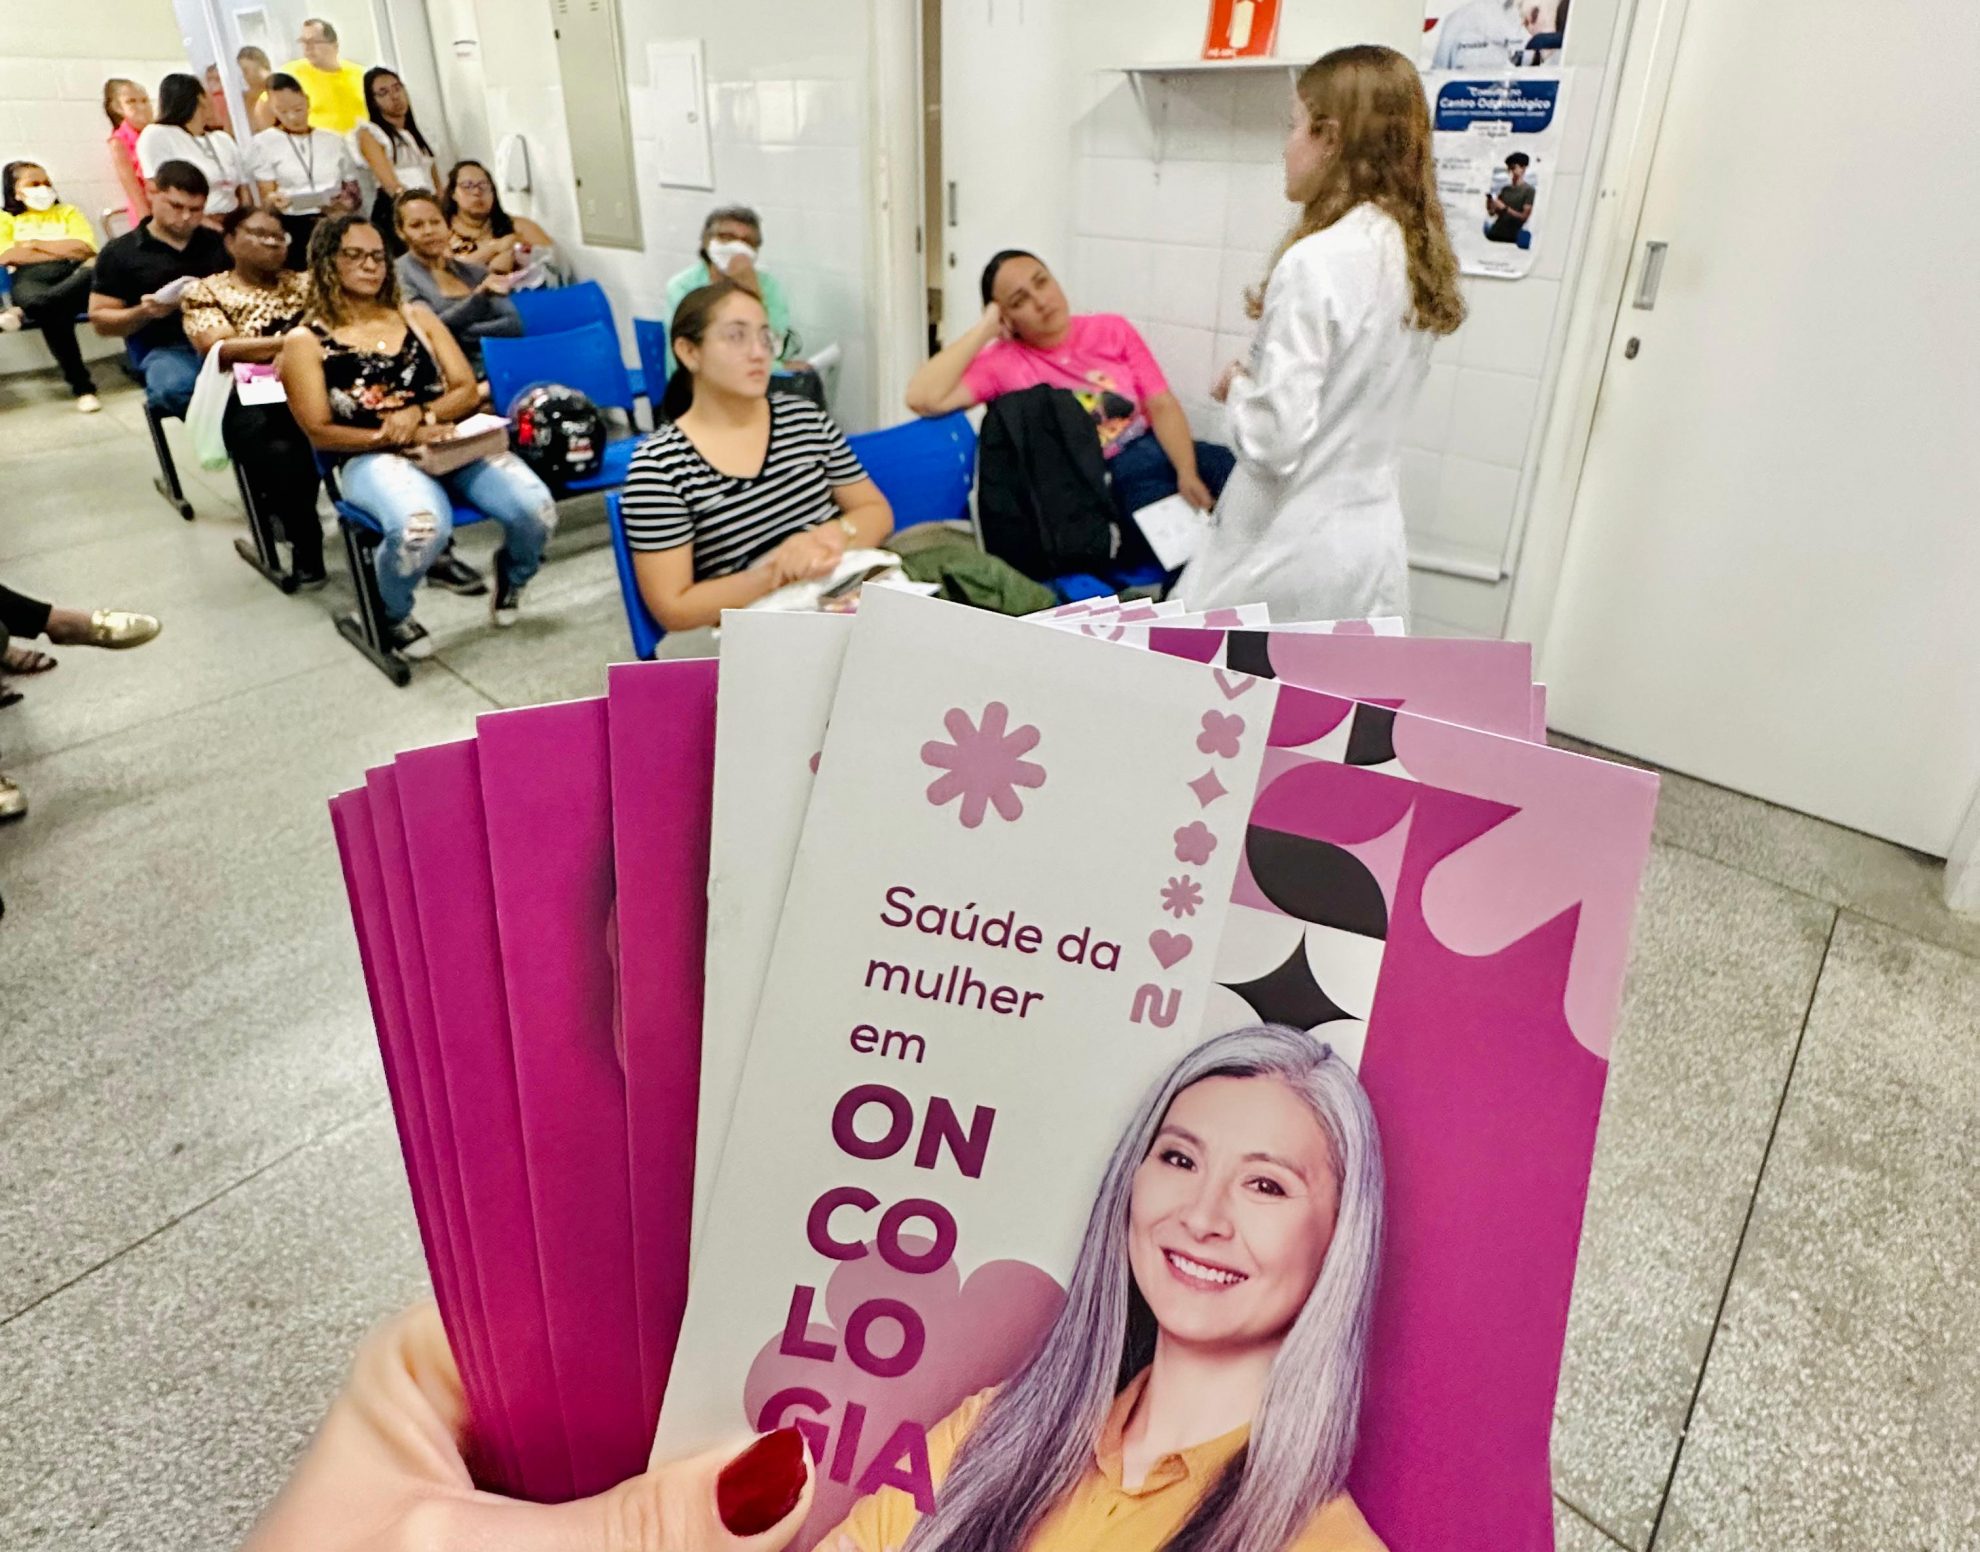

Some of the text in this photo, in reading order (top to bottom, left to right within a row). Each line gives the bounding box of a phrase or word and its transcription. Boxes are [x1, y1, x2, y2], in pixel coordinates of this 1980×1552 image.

[880, 886, 1121, 972] Saúde da
[864, 958, 1044, 1019] mulher
[850, 1024, 926, 1064] em
[831, 1083, 997, 1180] ON
[806, 1186, 958, 1276] CO
[779, 1284, 927, 1380] LO
[757, 1387, 937, 1517] GIA
